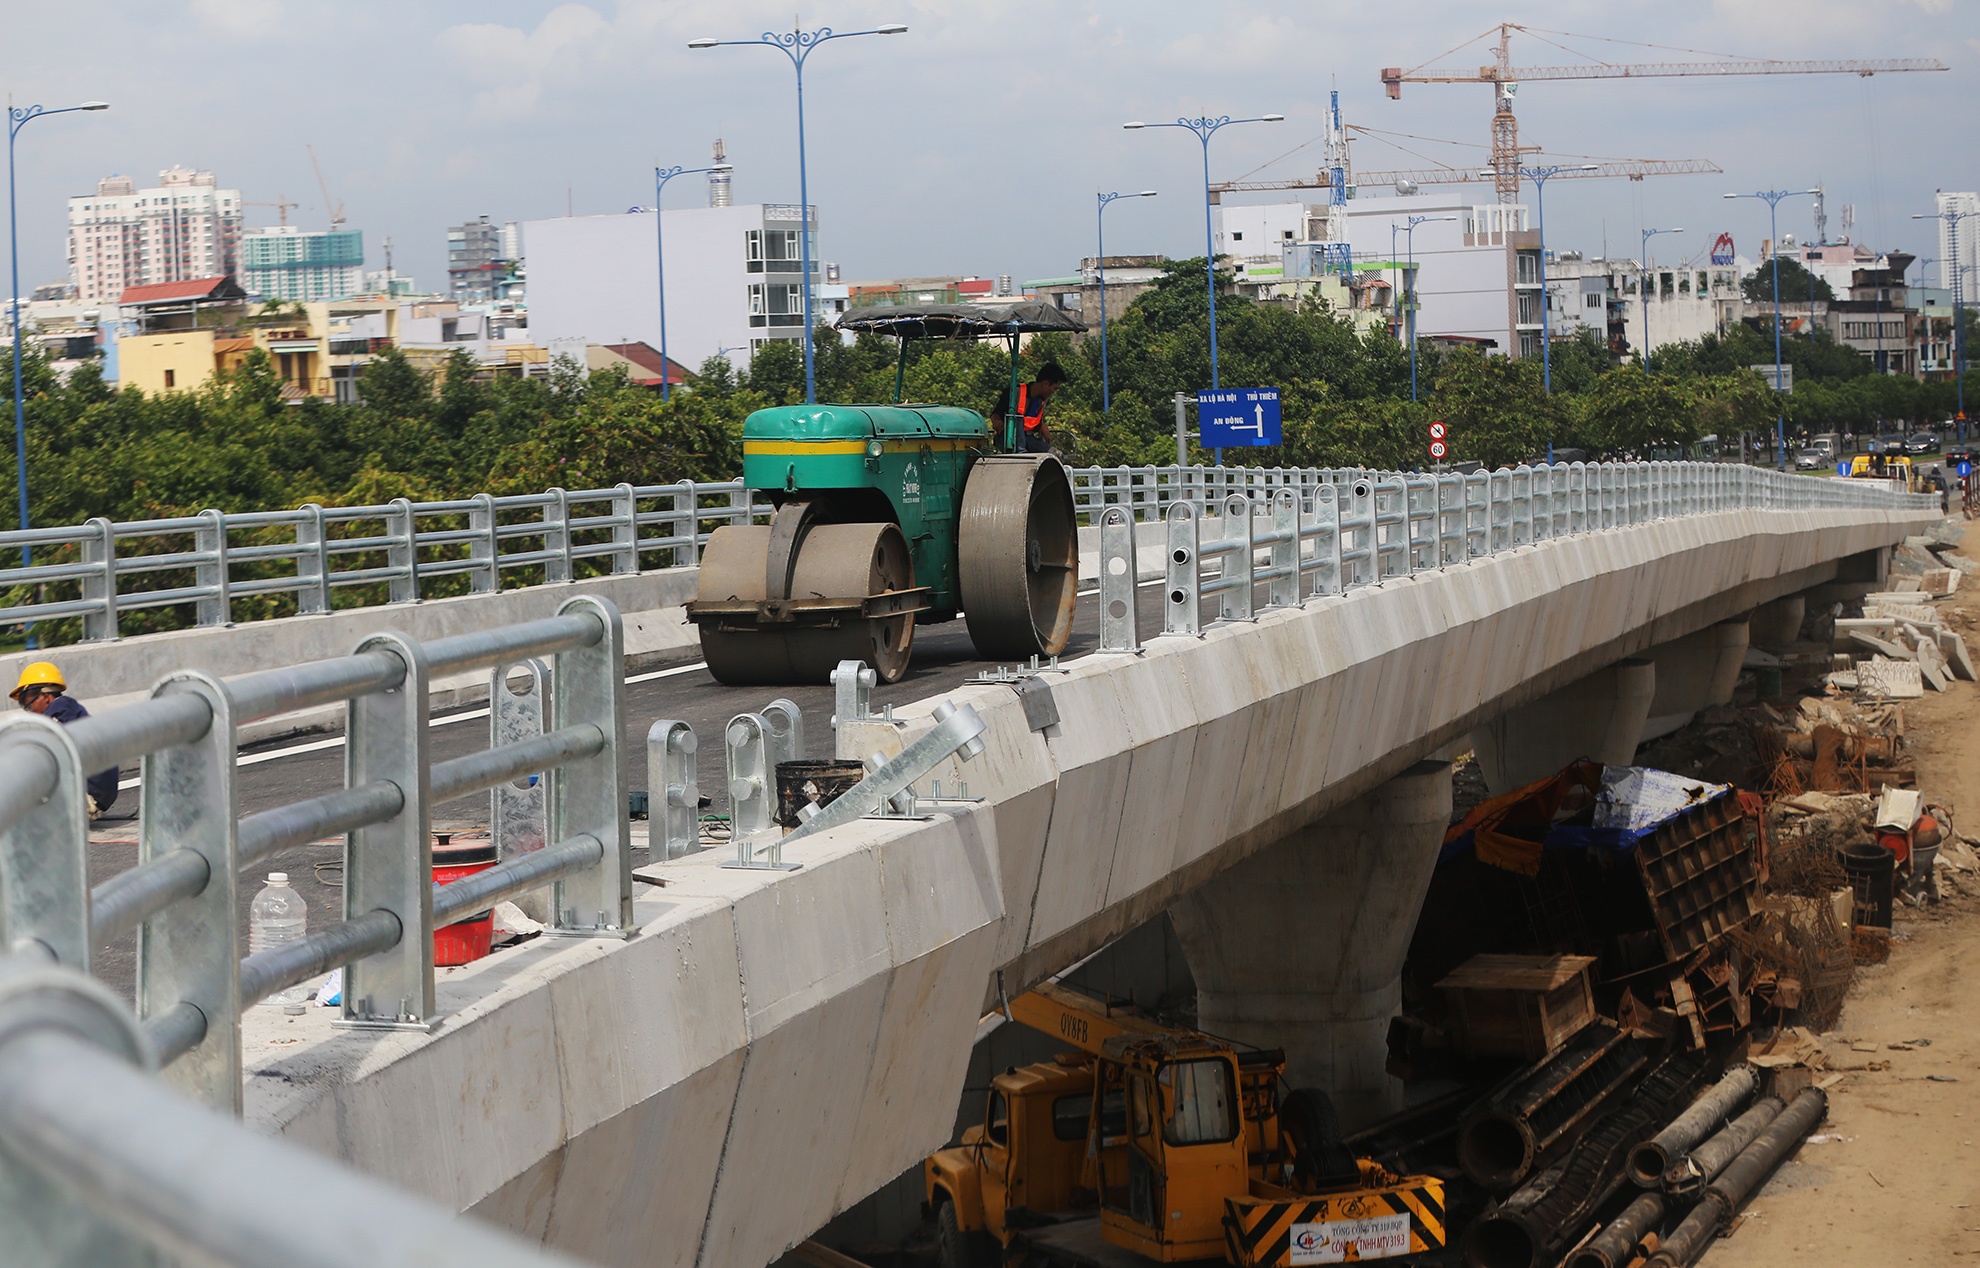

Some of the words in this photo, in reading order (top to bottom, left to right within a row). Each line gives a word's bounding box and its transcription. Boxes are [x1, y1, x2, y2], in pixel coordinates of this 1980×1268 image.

[1208, 394, 1215, 403] LỘ
[1227, 393, 1236, 403] NỘI
[1247, 391, 1258, 400] THỦ
[1433, 445, 1442, 454] 60
[1352, 1225, 1369, 1235] CÔNG
[1371, 1224, 1379, 1232] TY
[1360, 1237, 1376, 1251] TNHH
[1377, 1237, 1390, 1248] MTV
[1390, 1234, 1405, 1247] 319.3
